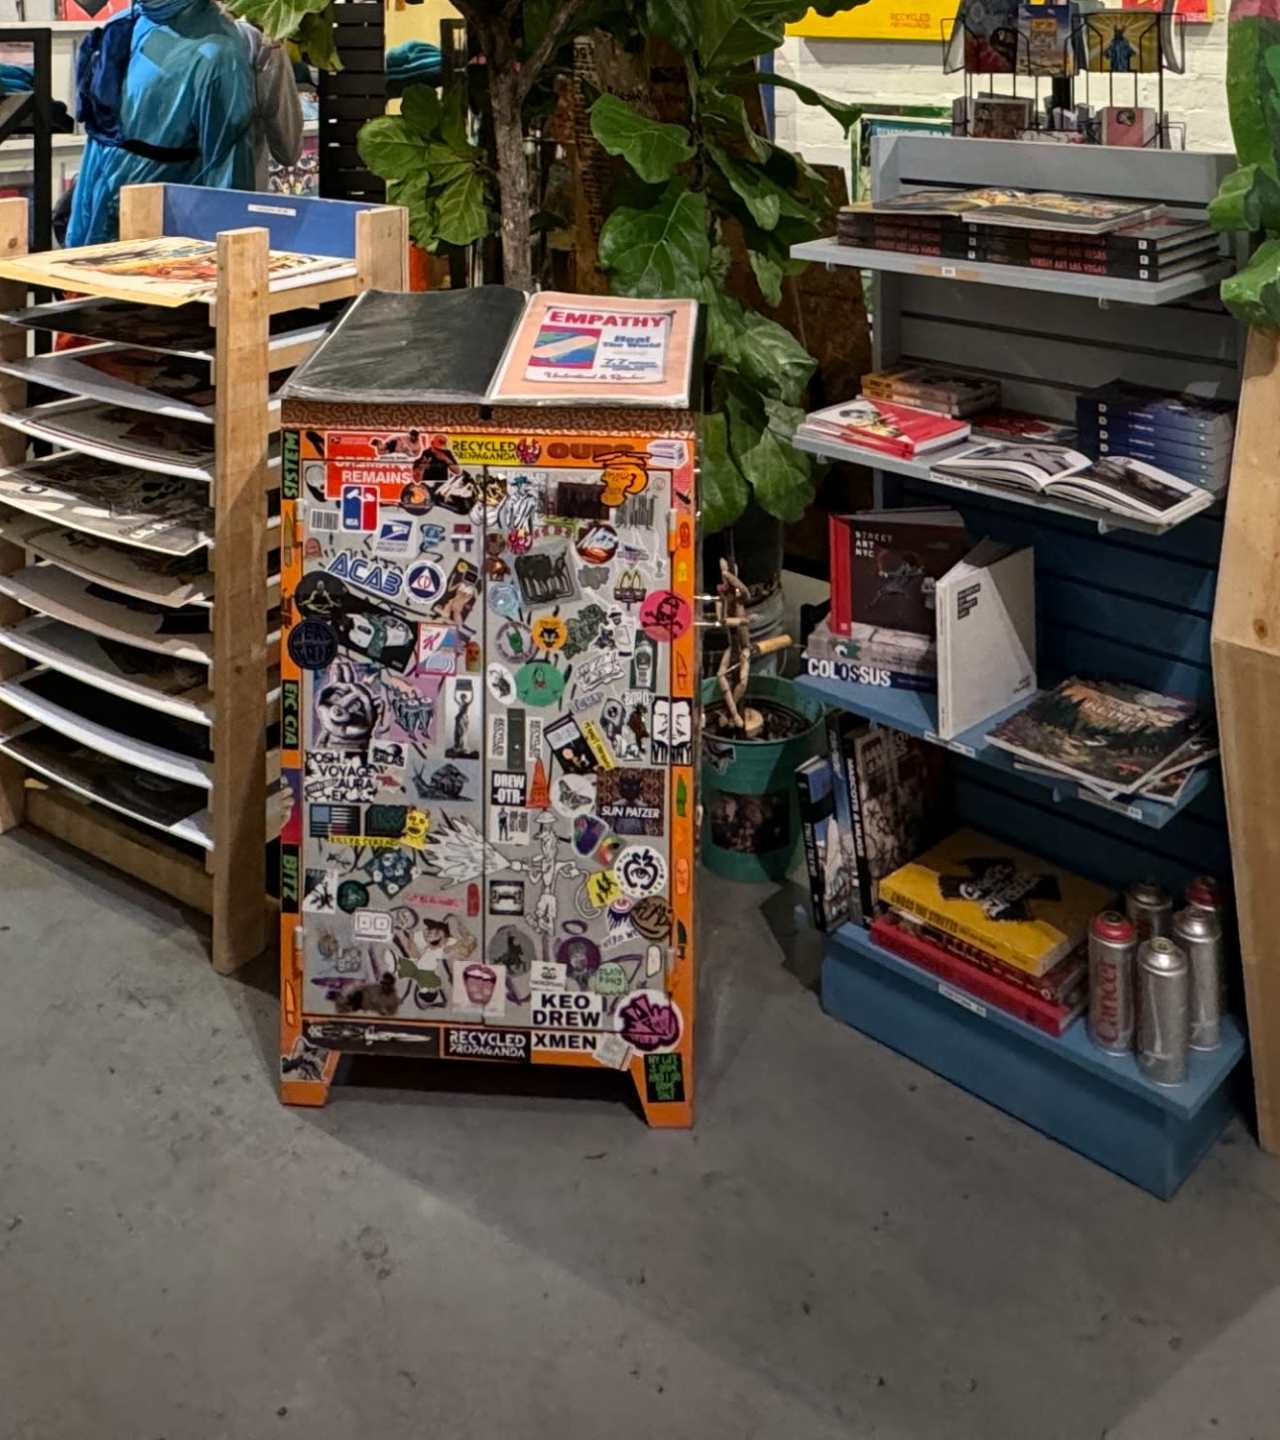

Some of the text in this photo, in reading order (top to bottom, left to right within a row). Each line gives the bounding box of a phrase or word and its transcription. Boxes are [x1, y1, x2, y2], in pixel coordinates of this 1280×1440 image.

[549, 311, 665, 328] EMPATHY
[452, 440, 516, 453] RECYCLED
[342, 470, 413, 485] REMAINS
[807, 658, 892, 687] COLOSSUS
[305, 751, 342, 763] POSH
[493, 773, 525, 788] DREW
[601, 806, 661, 819] SUN PATZER
[541, 994, 590, 1008] KEO
[532, 1010, 601, 1027] DREW
[448, 1030, 527, 1048] RECYCLED
[533, 1032, 598, 1050] XMEN
[448, 1044, 526, 1058] PROPAGANDA
